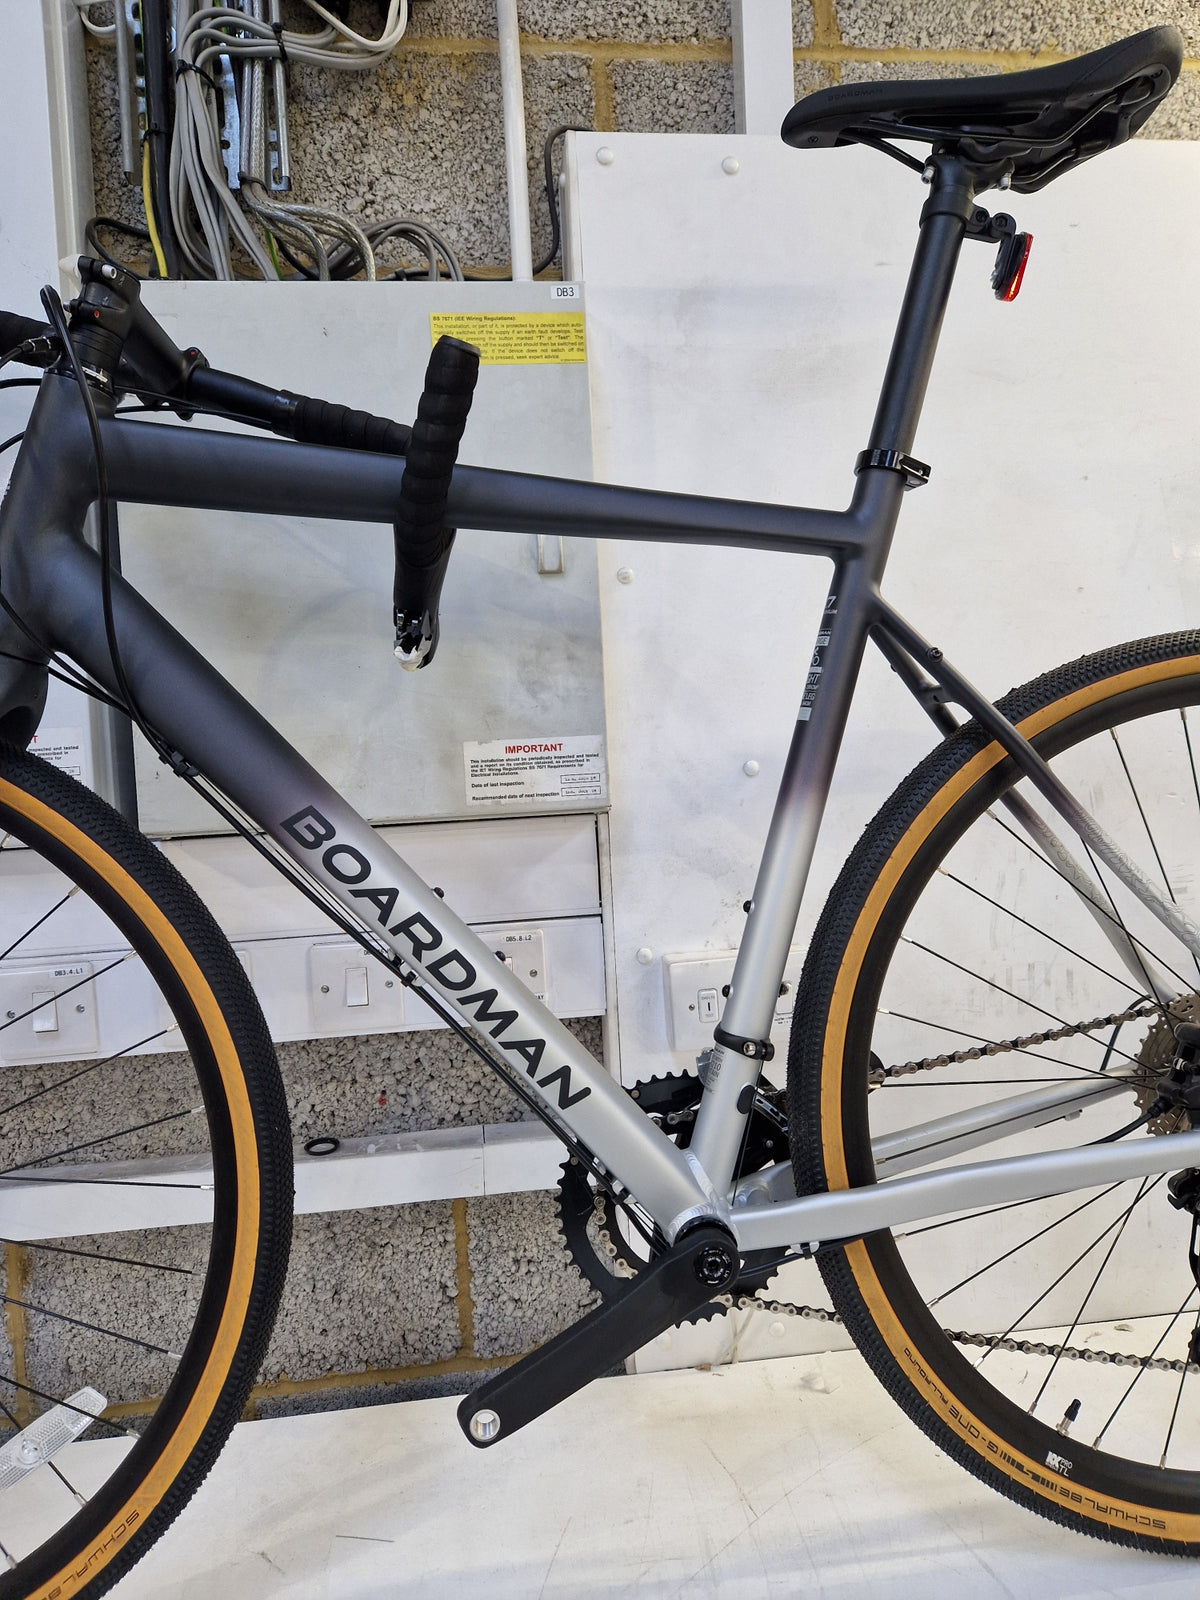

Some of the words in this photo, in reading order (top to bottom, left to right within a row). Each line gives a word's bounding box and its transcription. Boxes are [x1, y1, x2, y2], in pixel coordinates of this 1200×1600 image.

[556, 287, 574, 296] DB3
[505, 743, 563, 754] IMPORTANT
[280, 805, 592, 1110] BOARDMAN
[54, 968, 83, 976] DB3.4.L1
[904, 1347, 948, 1404] ALLROUND
[948, 1404, 998, 1454] G-ONE
[1060, 1456, 1072, 1468] PRO
[1059, 1465, 1069, 1476] TL
[1059, 1486, 1166, 1530] SCHWALBE
